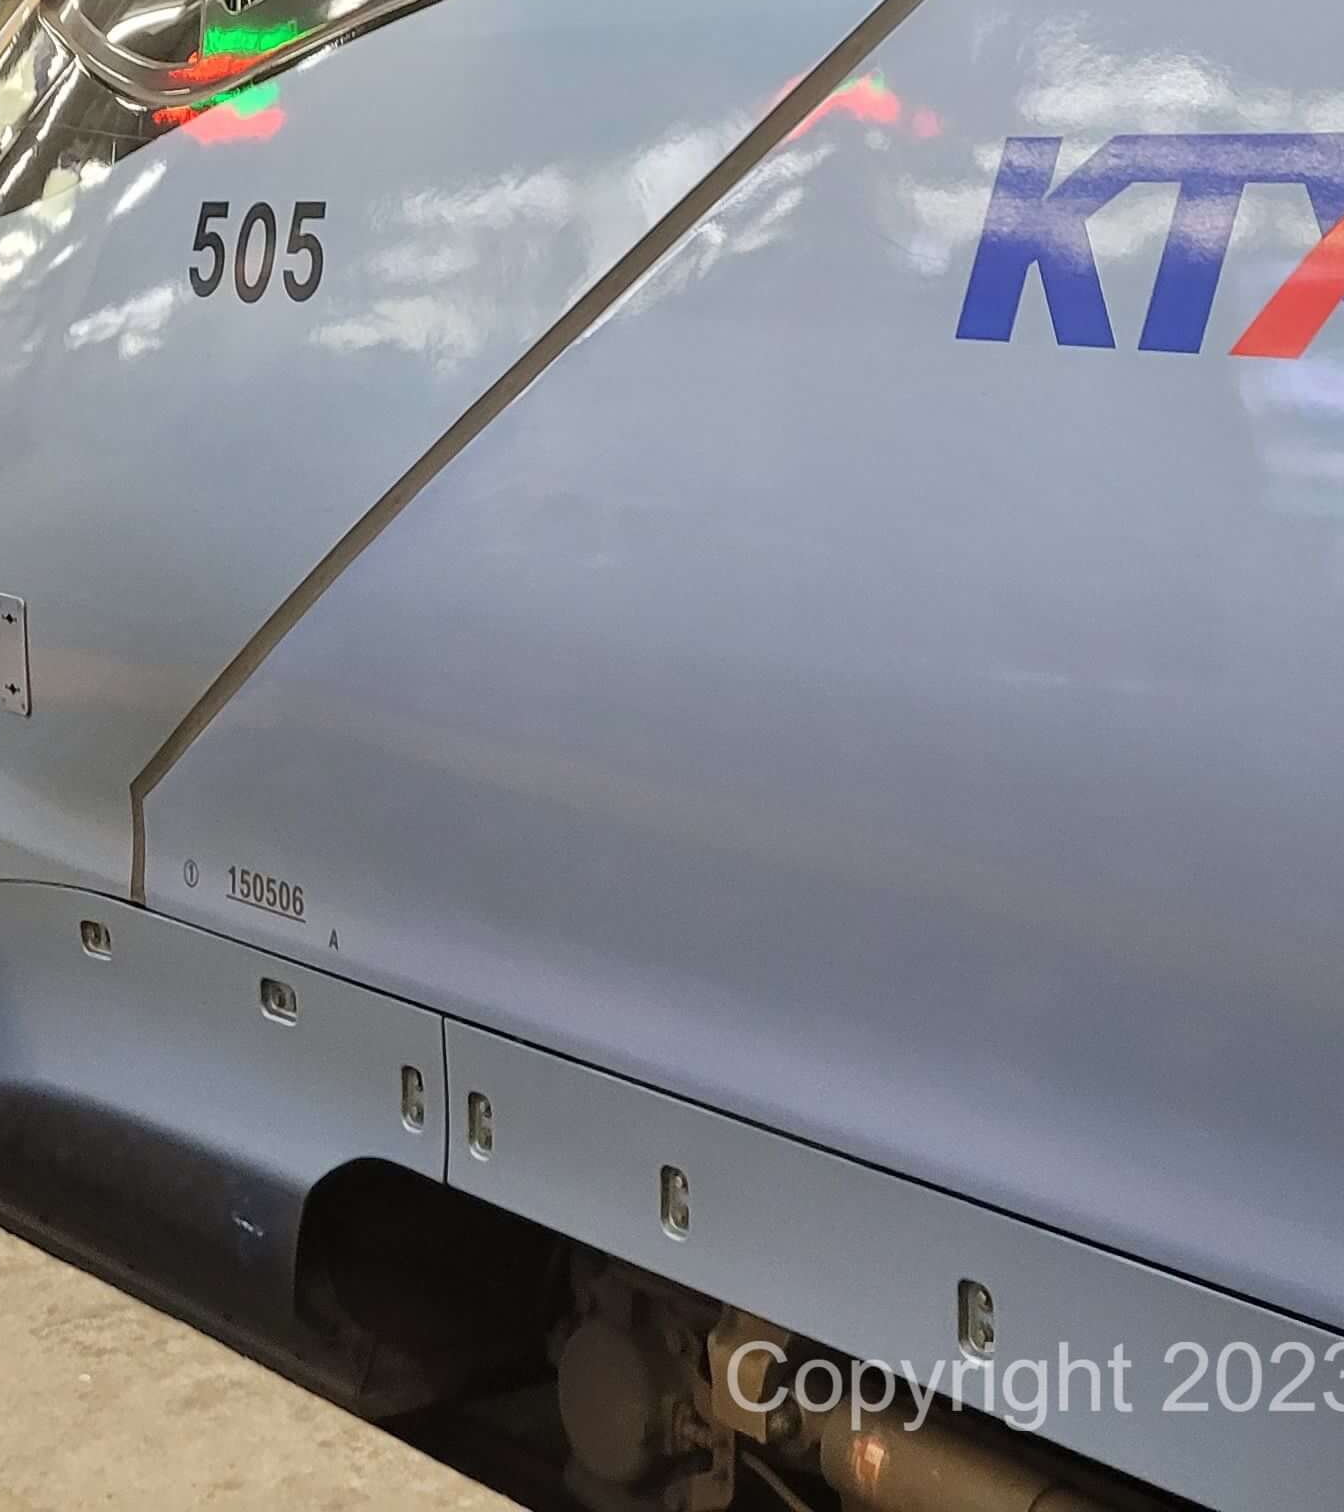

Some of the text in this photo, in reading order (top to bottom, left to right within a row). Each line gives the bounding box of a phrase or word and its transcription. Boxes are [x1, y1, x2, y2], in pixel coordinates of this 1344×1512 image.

[189, 201, 326, 303] 505
[228, 865, 305, 916] 150506
[328, 928, 339, 952] A
